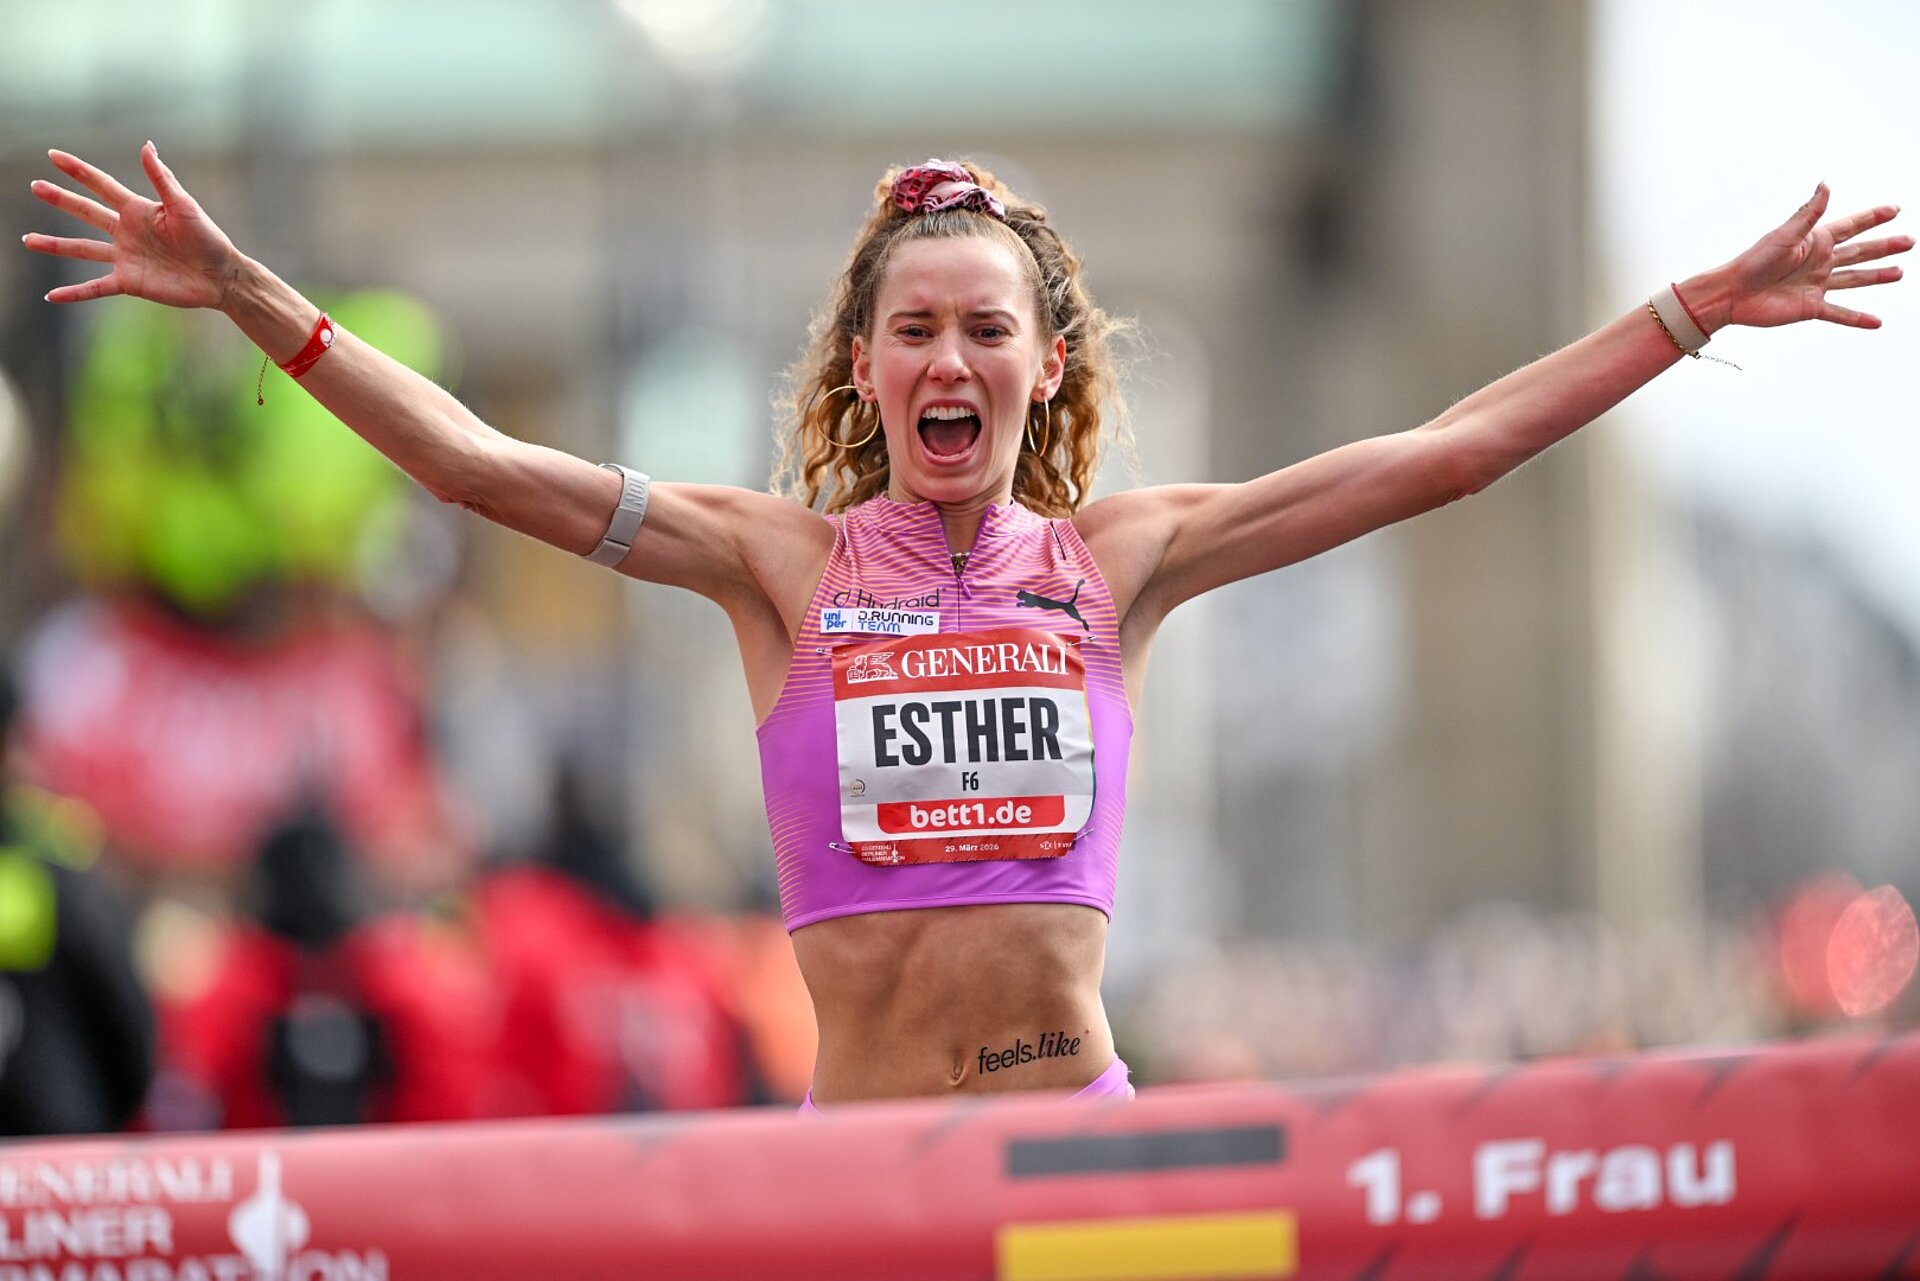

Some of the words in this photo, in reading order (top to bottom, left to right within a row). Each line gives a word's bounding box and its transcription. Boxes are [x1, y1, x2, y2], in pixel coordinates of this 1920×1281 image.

[824, 611, 841, 620] uni
[827, 620, 847, 630] per
[858, 621, 901, 633] TEAM
[901, 642, 1069, 679] GENERALI
[872, 697, 1063, 767] ESTHER
[962, 771, 979, 791] F6
[910, 800, 1032, 829] bett1.de
[959, 843, 978, 852] März
[978, 1031, 1081, 1075] feels.like
[1346, 1147, 1443, 1226] 1.
[1473, 1137, 1736, 1220] Frau
